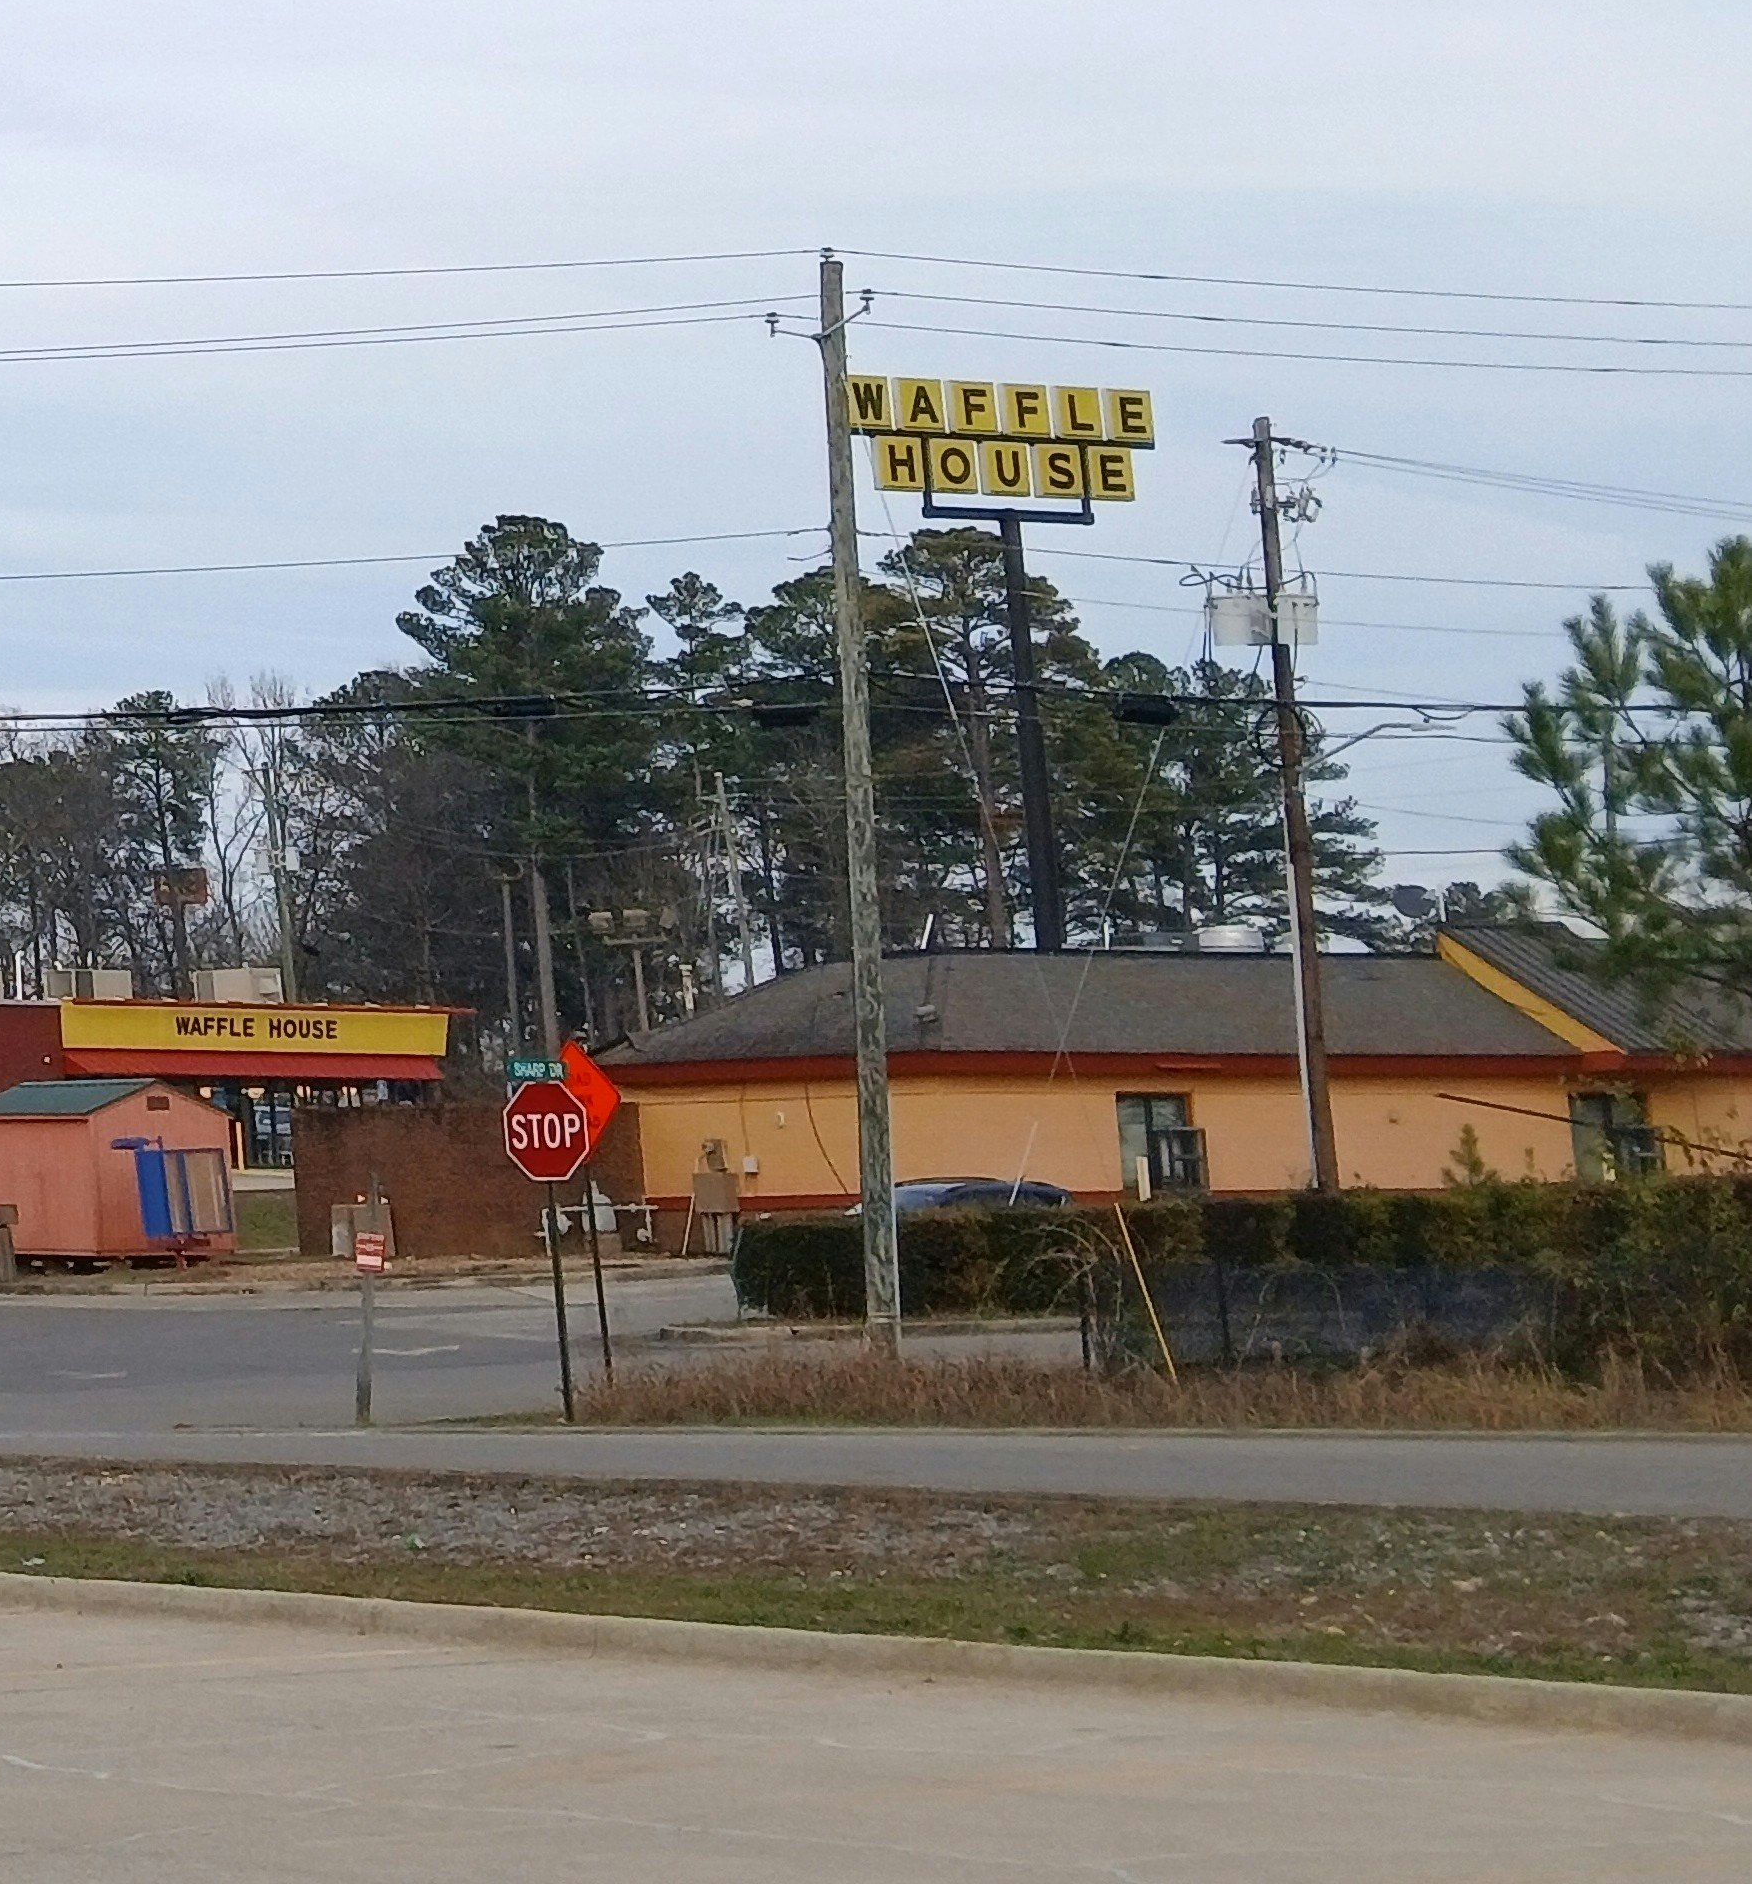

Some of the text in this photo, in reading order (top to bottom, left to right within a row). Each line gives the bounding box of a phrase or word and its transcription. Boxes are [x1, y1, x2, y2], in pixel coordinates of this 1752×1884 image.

[851, 381, 1148, 435] WAFFLE
[887, 443, 1129, 493] HOUSE
[174, 1015, 339, 1040] WAFFLE HOUSE
[513, 1061, 546, 1078] SHARP
[511, 1112, 582, 1150] STOP
